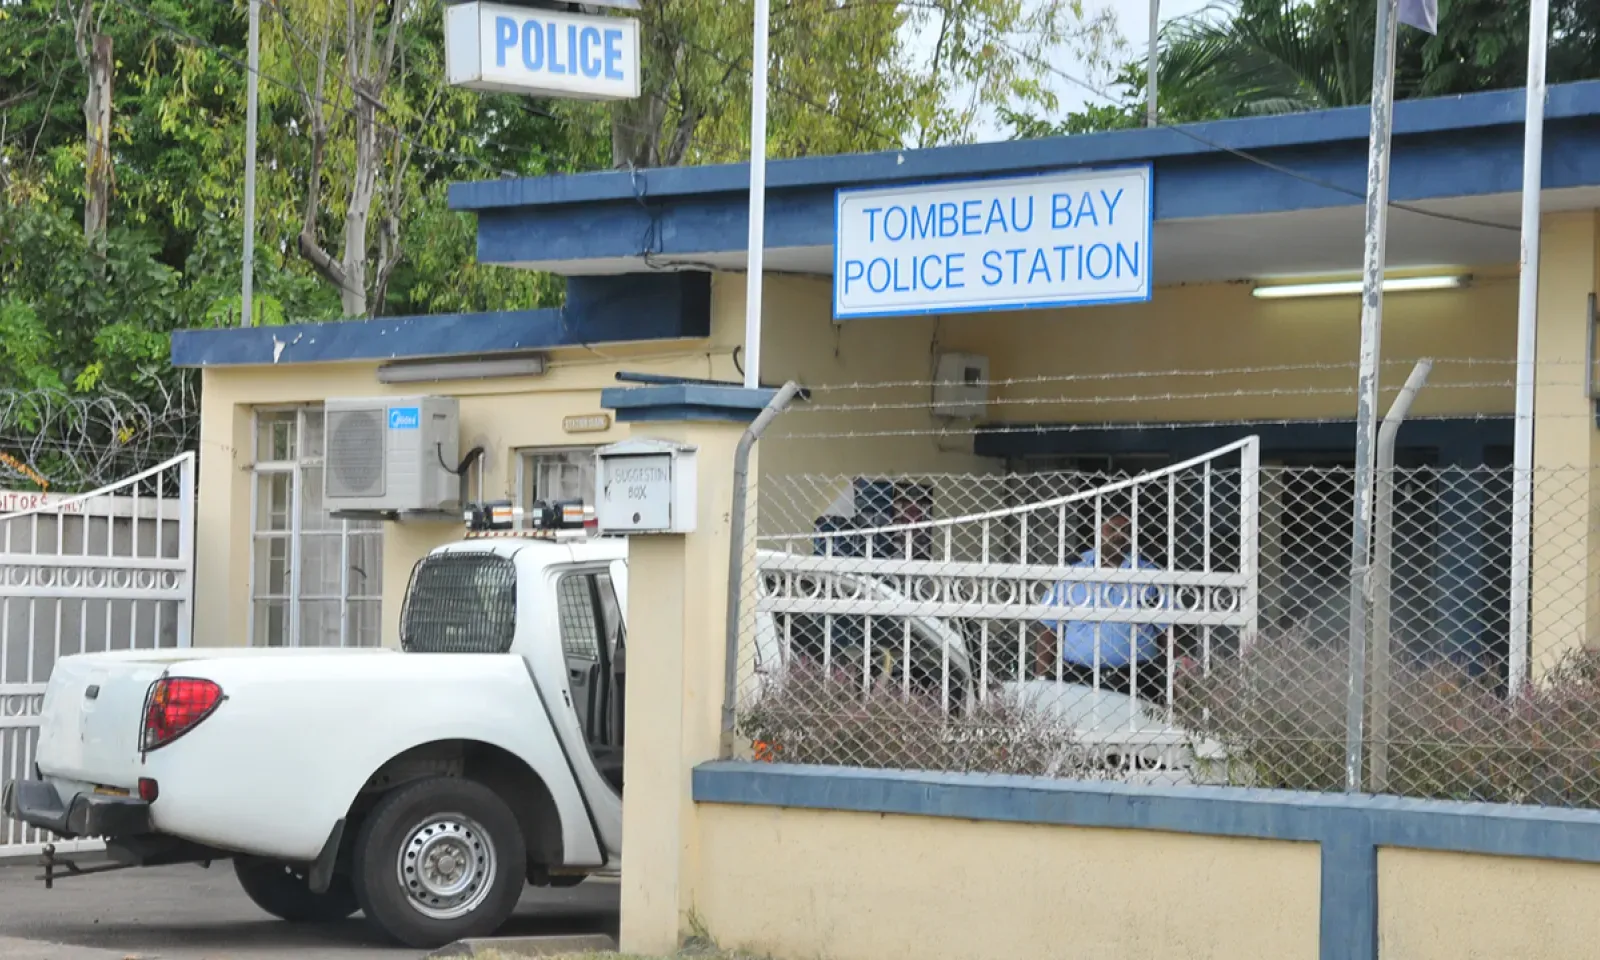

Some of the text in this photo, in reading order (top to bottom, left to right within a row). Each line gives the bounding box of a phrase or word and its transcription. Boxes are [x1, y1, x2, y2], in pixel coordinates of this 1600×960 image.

[495, 15, 624, 81] POLICE
[862, 188, 1124, 243] TOMBEAU BAY
[844, 241, 1140, 295] POLICE STATION
[628, 484, 647, 500] BOX
